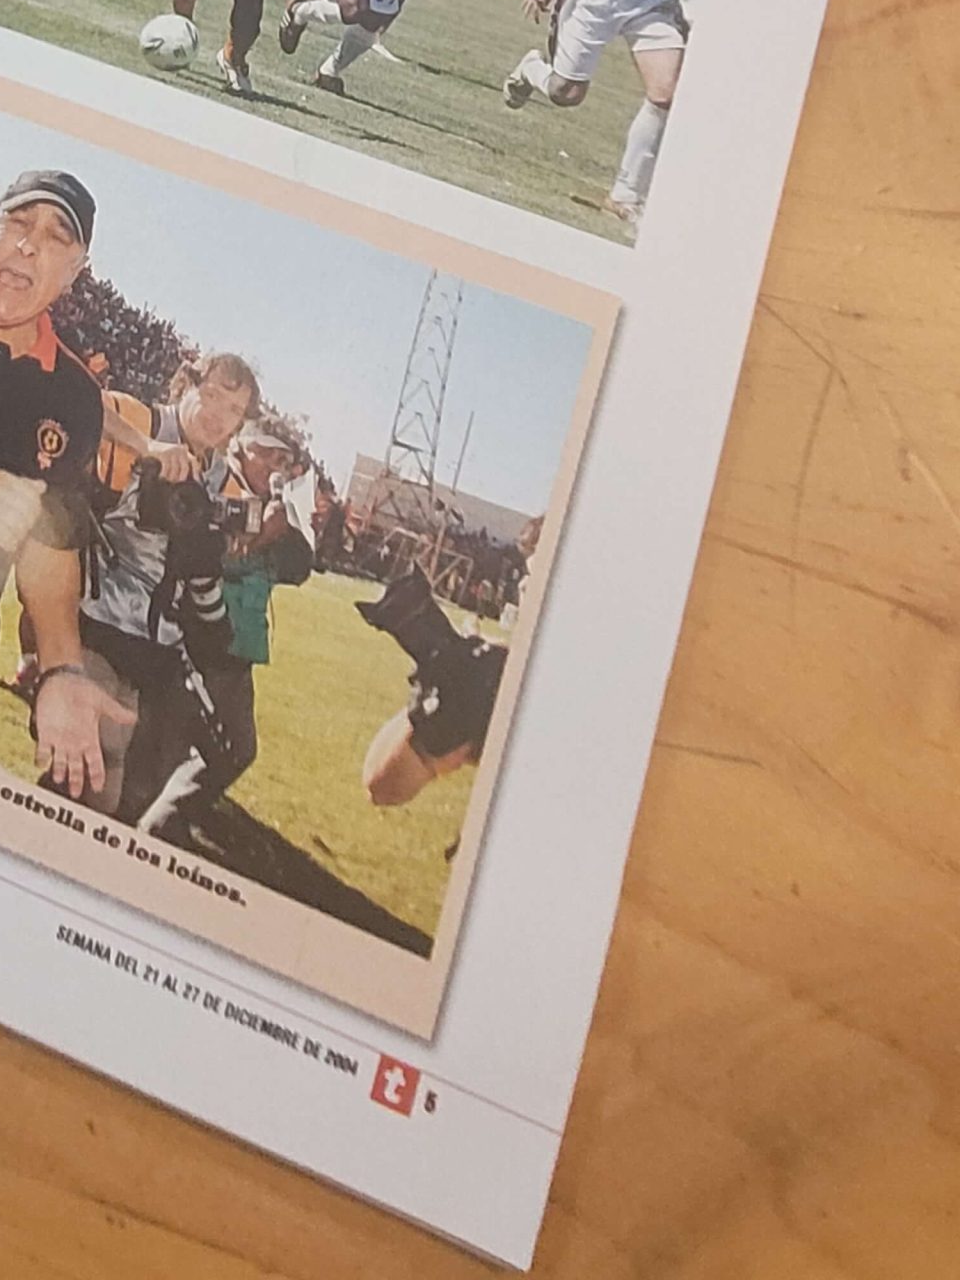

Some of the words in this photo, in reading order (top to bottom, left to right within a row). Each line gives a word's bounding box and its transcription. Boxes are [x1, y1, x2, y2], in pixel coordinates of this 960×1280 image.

[0, 787, 85, 835] estrella
[92, 825, 121, 849] de
[126, 837, 161, 868] los
[166, 855, 246, 907] loínos.
[56, 924, 111, 964] SEMANA
[115, 950, 138, 977] DEL
[143, 964, 160, 985] 21
[162, 974, 178, 996] AL
[182, 982, 200, 1003] 27
[203, 991, 222, 1014] DE
[224, 1001, 301, 1051] DICIEMBRE
[303, 1036, 322, 1060] DE
[324, 1048, 359, 1077] 2004
[424, 1090, 438, 1113] 5
